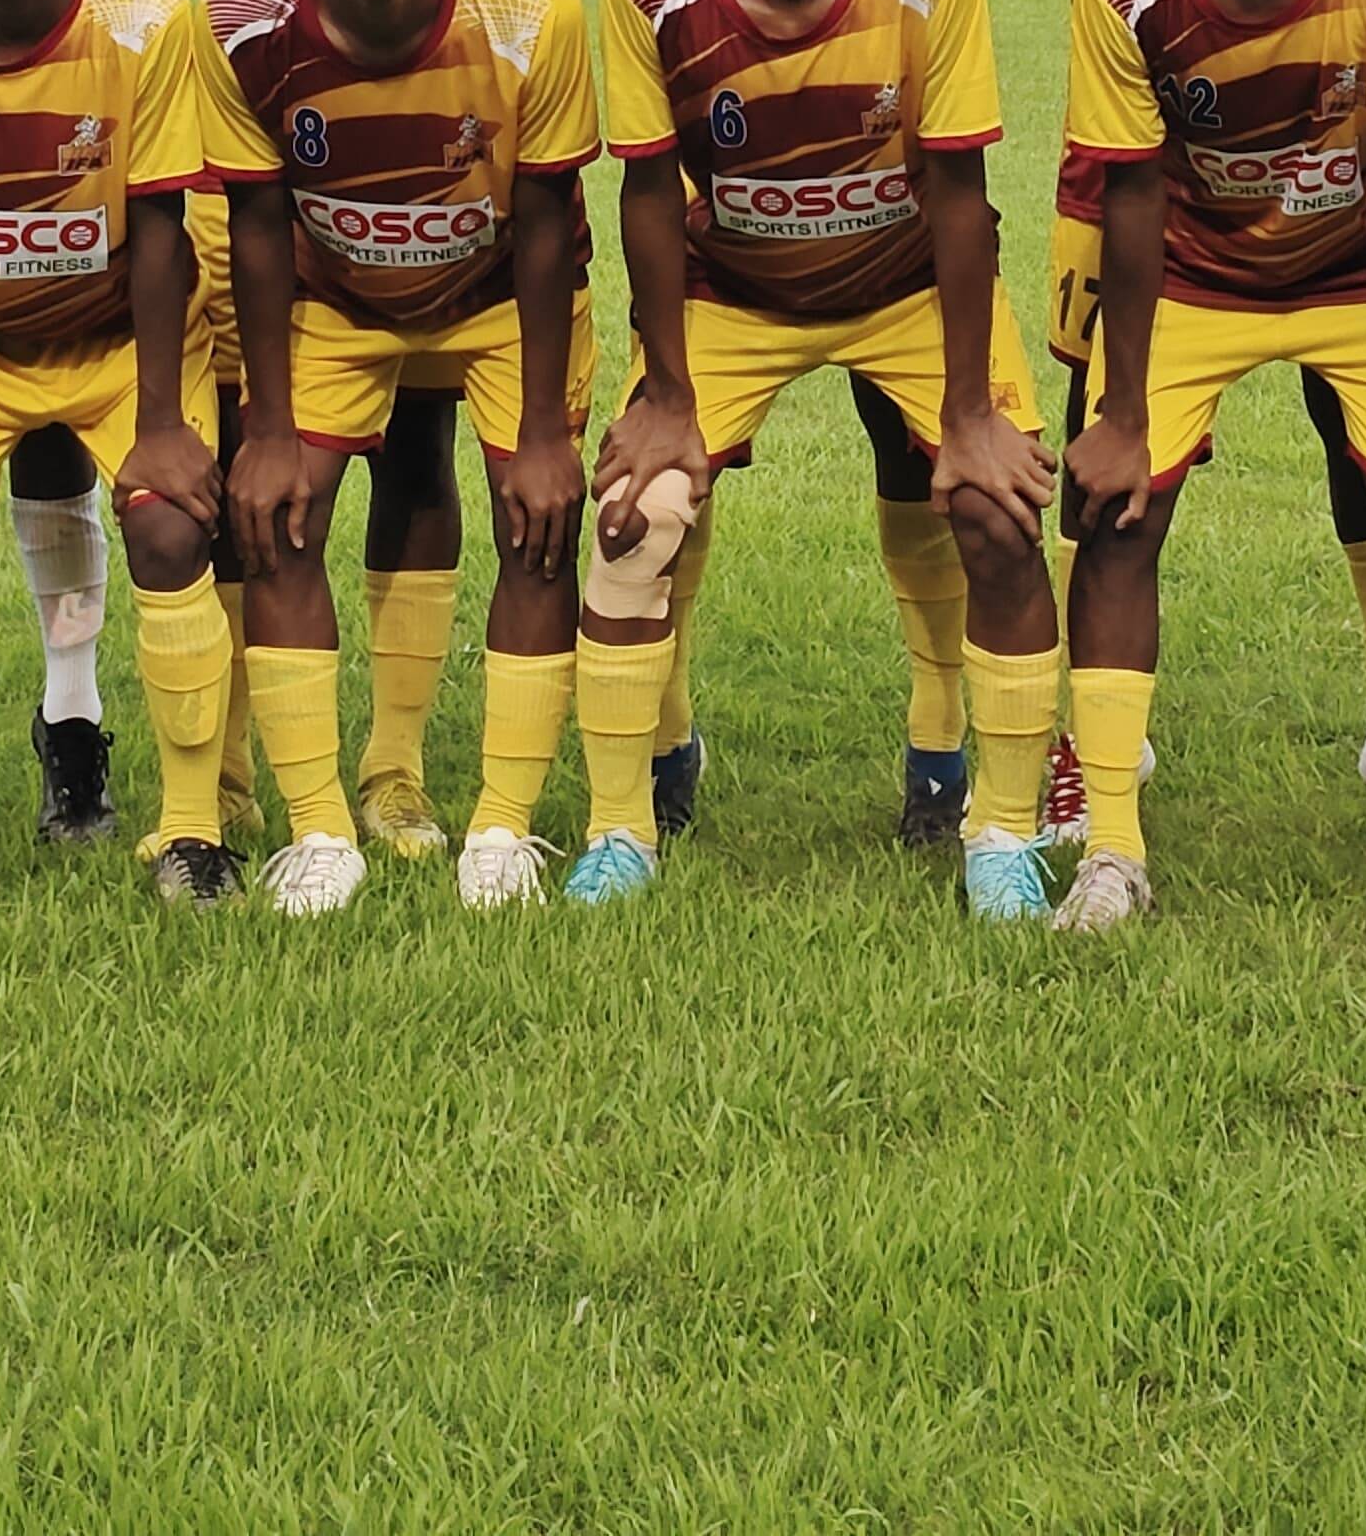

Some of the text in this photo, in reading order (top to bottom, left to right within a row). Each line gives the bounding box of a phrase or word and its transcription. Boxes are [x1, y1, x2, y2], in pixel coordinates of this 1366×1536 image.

[293, 106, 330, 167] 8
[710, 88, 747, 148] 6
[716, 172, 910, 218] COSCO
[300, 198, 490, 245] COSCO
[729, 204, 912, 236] SPORTS FITNESS
[5, 257, 93, 276] FITNESS
